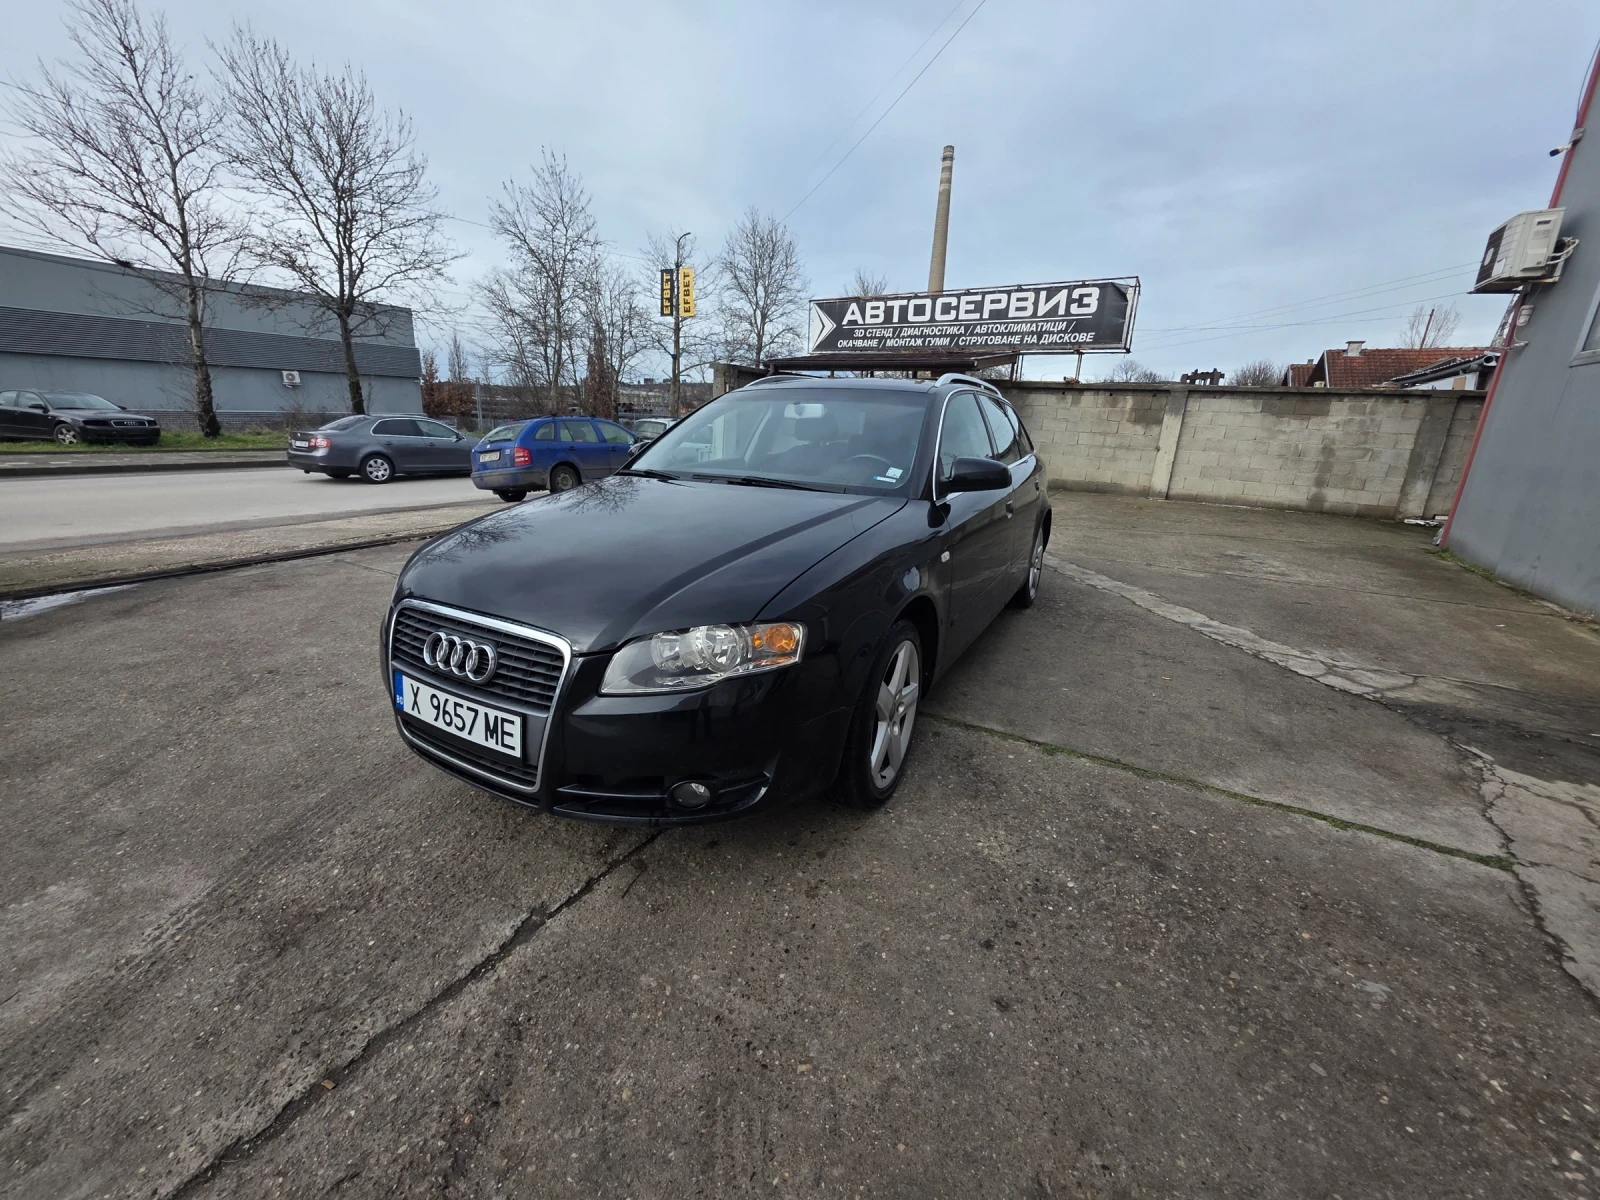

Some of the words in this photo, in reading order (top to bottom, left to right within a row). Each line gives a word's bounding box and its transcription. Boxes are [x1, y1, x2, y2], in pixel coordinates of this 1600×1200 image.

[663, 272, 671, 314] EFBET
[683, 271, 691, 313] EFBET
[841, 286, 1100, 325] АВТОСЕРВИЗ
[837, 339, 879, 348] ОКАЧВАНЕ
[886, 338, 924, 347] МОНТАЖ
[925, 337, 950, 346] ГУМИ
[958, 335, 1022, 345] СТРУГОВАНЕ
[1023, 334, 1037, 344] НА
[1039, 332, 1096, 344] ДИСКОВЕ
[853, 329, 865, 337] 3D
[866, 328, 893, 338] СТЕНД
[900, 325, 965, 337] ДИАГНОСТИКА
[974, 321, 1067, 334] АВТОКЛИМАТИЦИ
[410, 683, 421, 715] X
[430, 693, 479, 736] 9657
[484, 711, 516, 751] ME
